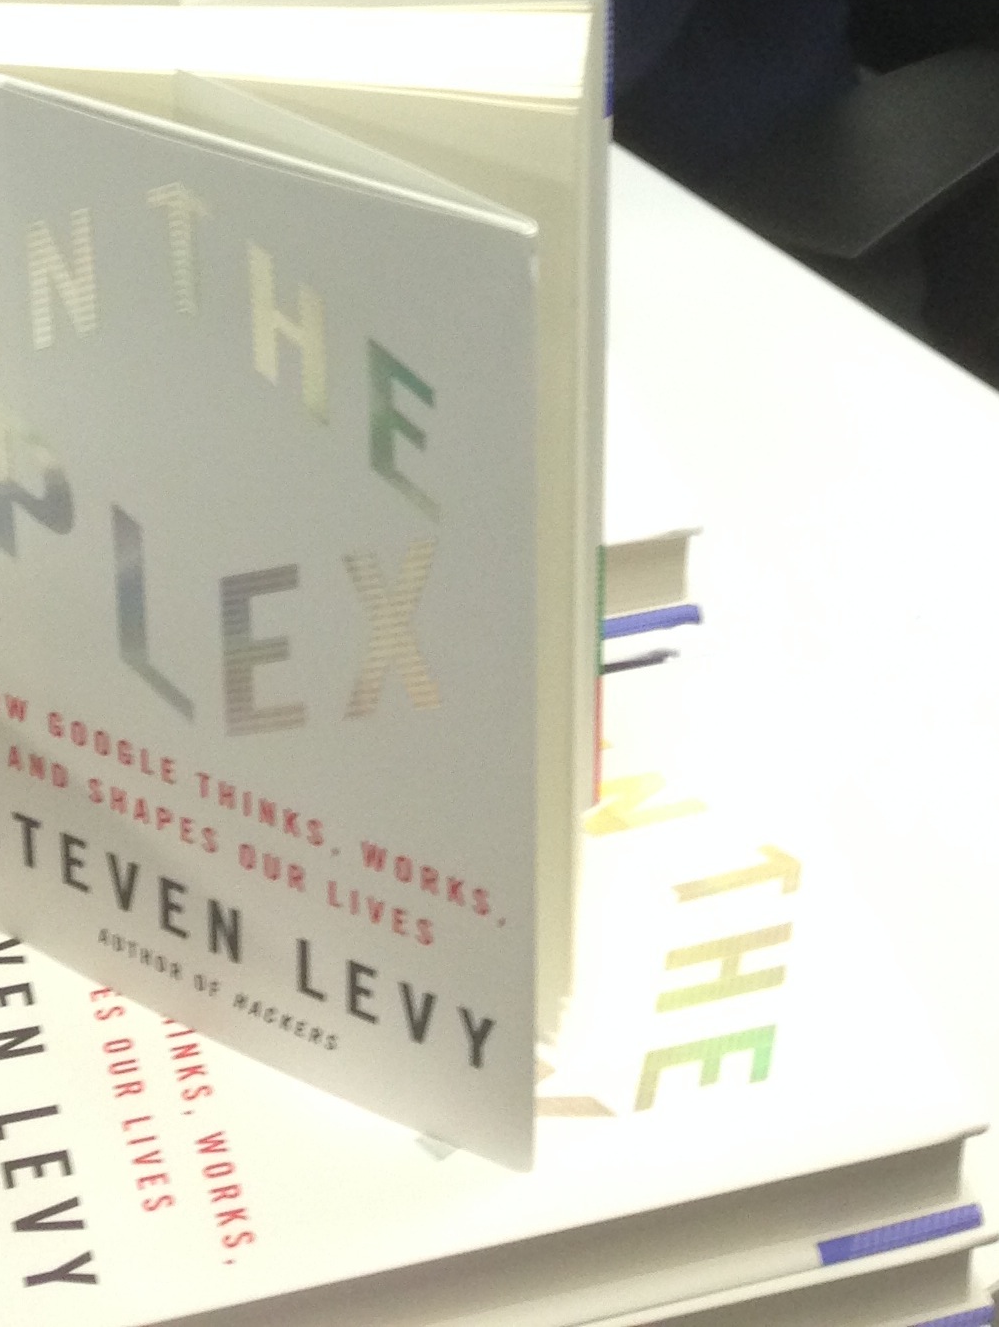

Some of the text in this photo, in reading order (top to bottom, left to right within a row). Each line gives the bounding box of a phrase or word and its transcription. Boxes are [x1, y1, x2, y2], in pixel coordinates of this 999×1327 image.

[146, 181, 442, 524] THE
[47, 711, 177, 785] GOOGLE
[7, 745, 435, 945] AND SHAPES OUR LIVES
[97, 928, 339, 1052] AUTHOR OF HACKERS
[296, 938, 496, 1070] LEVY
[633, 843, 802, 1114] THE
[102, 1037, 146, 1100] OUR
[162, 1017, 214, 1116] INKS,
[120, 1114, 177, 1214] LIVES
